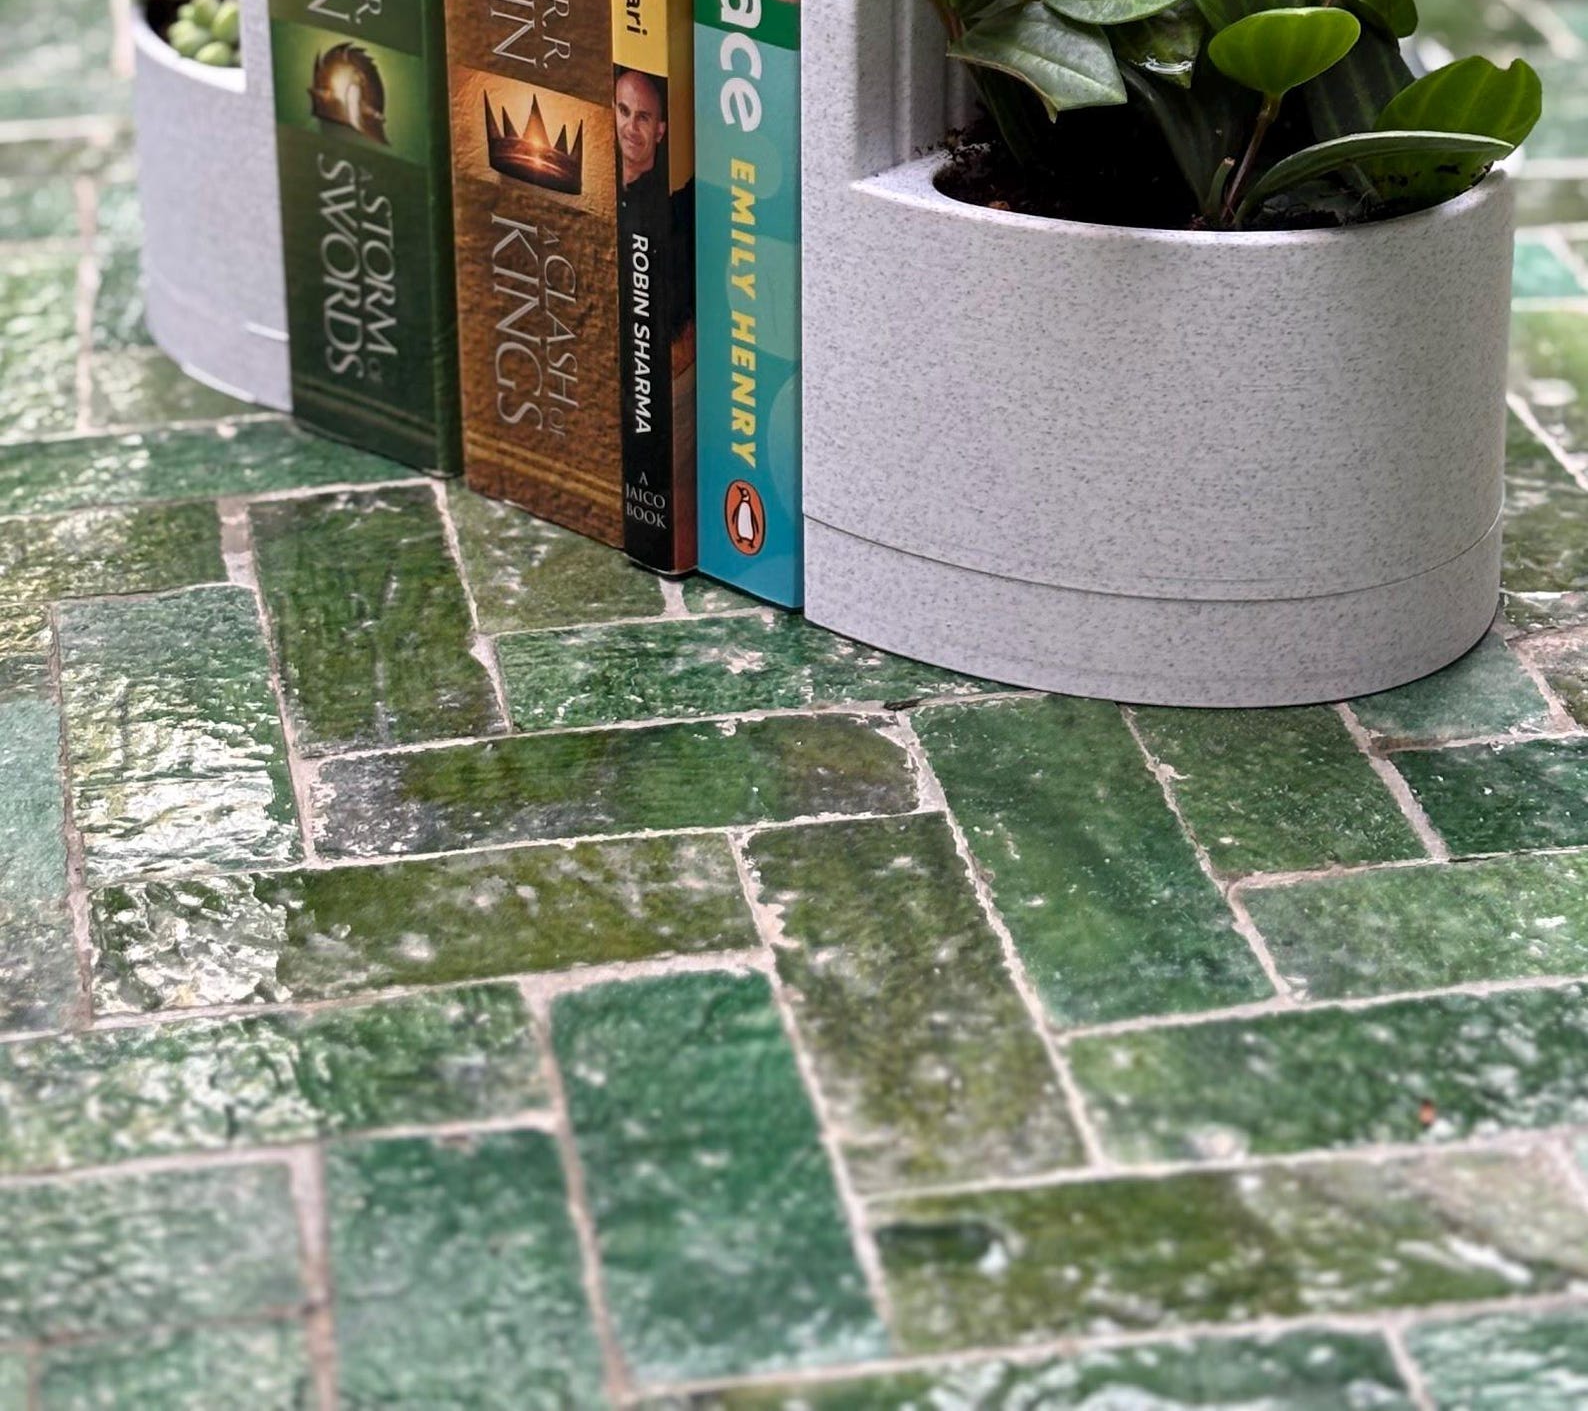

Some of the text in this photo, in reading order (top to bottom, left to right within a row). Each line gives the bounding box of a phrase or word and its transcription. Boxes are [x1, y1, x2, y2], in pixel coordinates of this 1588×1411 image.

[316, 152, 365, 379] SWORDS
[360, 189, 398, 356] STORM
[490, 212, 544, 431] KINGS
[544, 254, 580, 408] CLASH
[631, 231, 653, 434] ROBIN SHARMA
[730, 157, 758, 471] EMILY HENRY
[626, 502, 667, 529] BOOK
